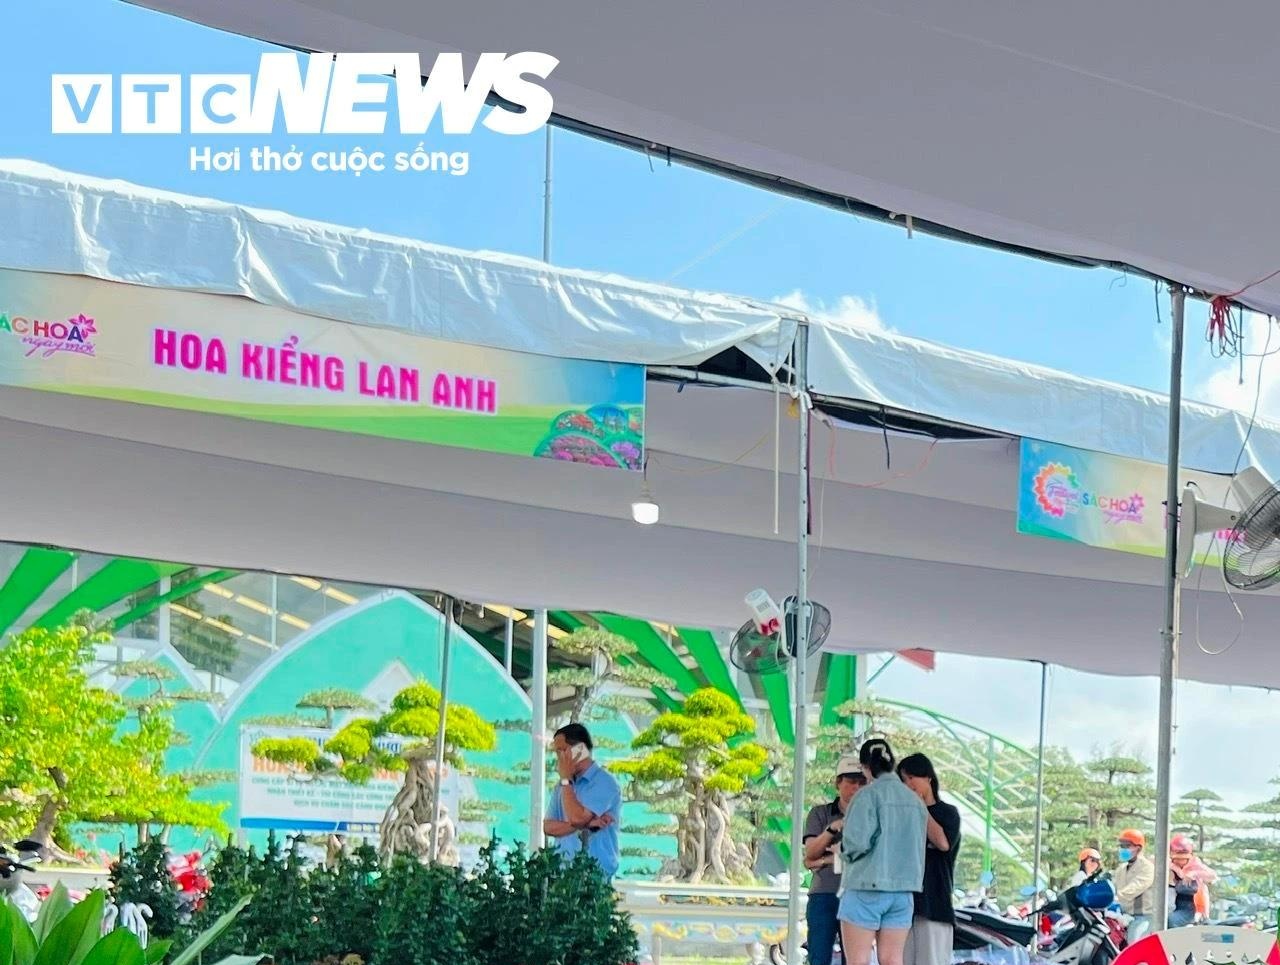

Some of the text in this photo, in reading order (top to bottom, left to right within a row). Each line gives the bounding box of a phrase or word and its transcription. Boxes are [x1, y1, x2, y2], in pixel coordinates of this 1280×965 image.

[33, 319, 84, 343] HOA
[154, 328, 496, 413] HOA KIỂNG LAN ANH
